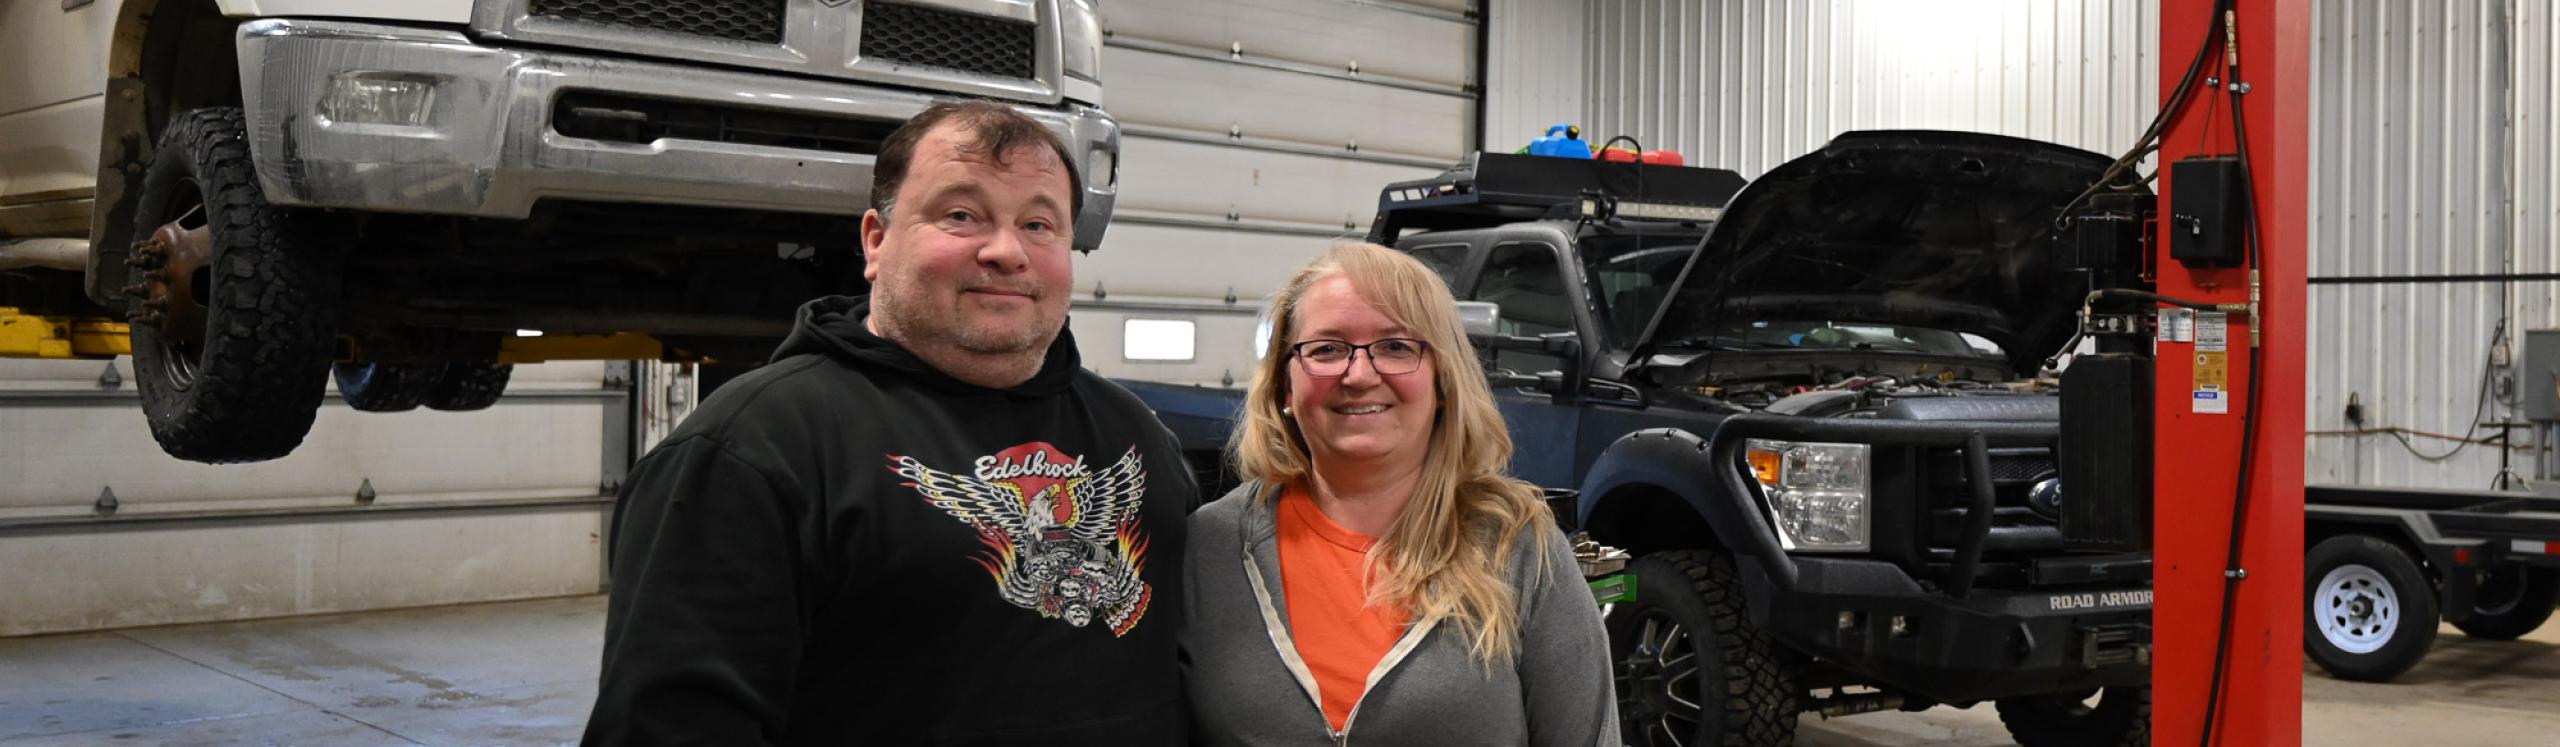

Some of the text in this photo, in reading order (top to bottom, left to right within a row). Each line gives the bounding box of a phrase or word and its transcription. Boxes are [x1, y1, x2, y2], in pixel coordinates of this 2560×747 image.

[975, 450, 1090, 480] Edelbrock
[2050, 591, 2153, 610] ROAD ARMOR
